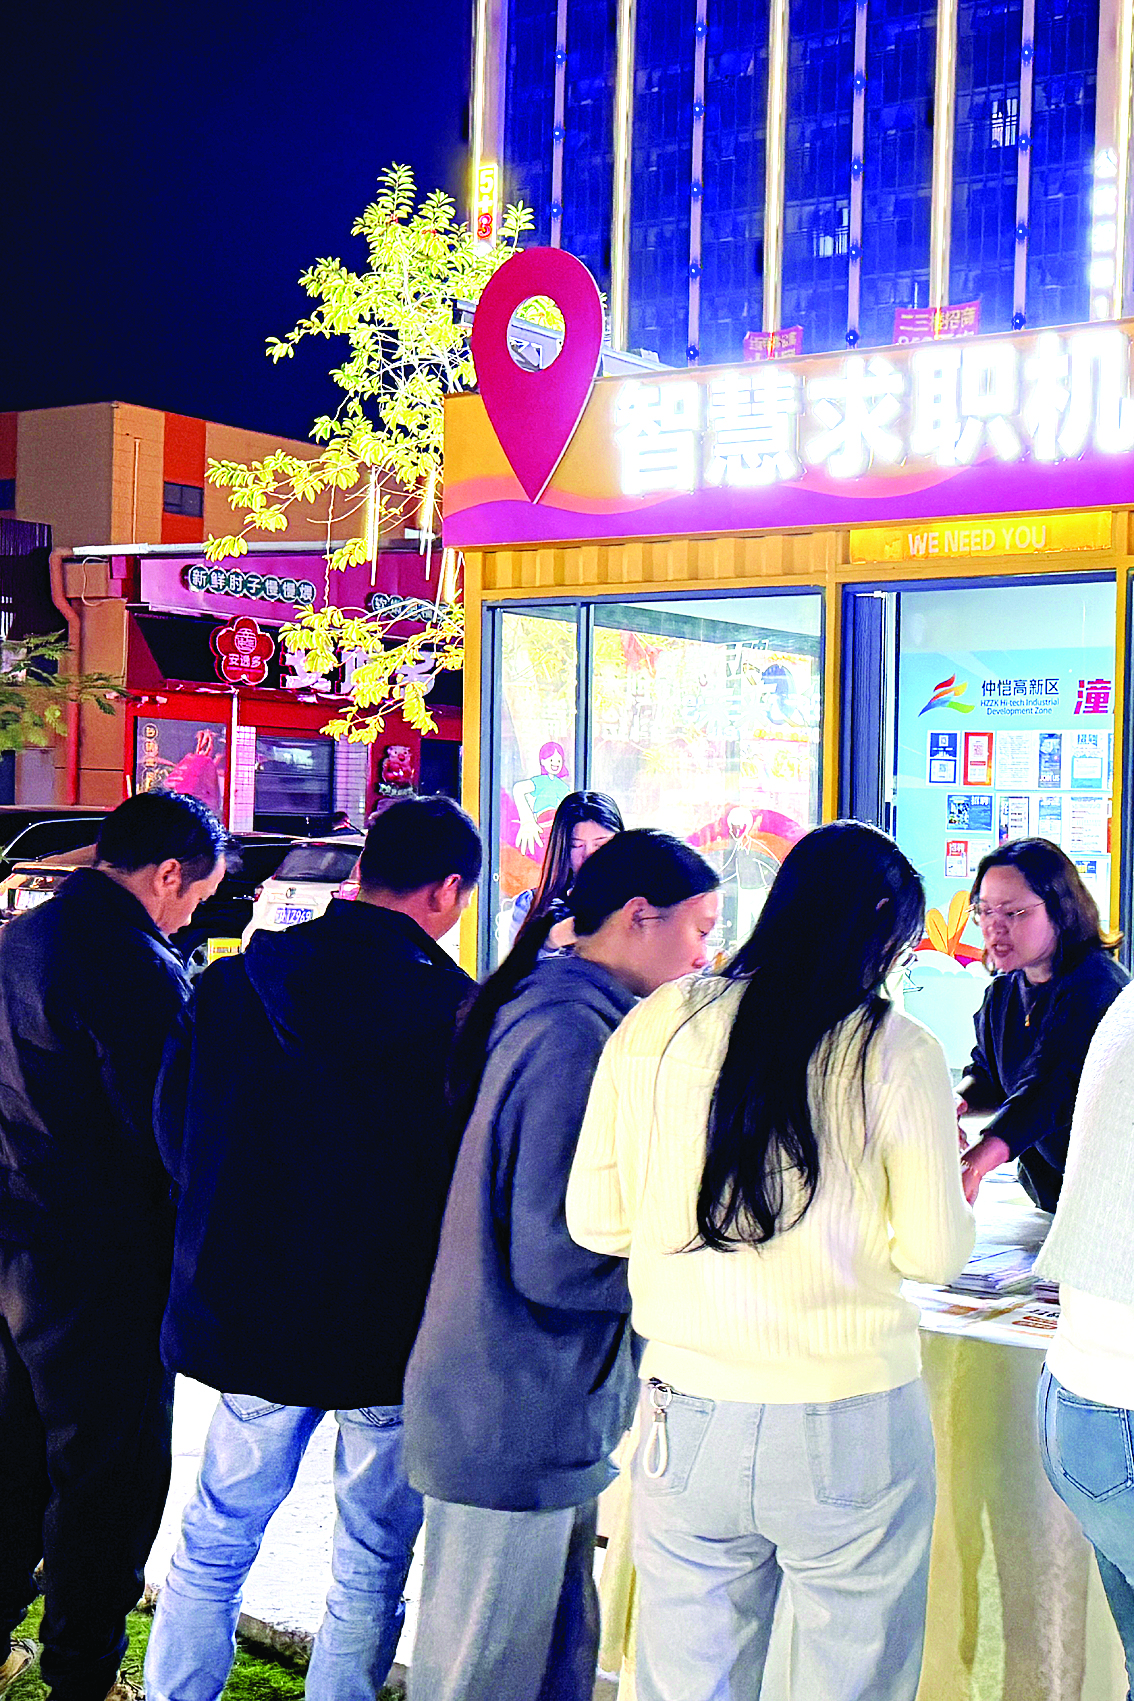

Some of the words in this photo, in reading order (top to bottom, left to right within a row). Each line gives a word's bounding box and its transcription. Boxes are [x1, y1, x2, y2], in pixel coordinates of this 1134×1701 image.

[908, 532, 939, 555] WE
[944, 529, 996, 553] NEED
[1001, 525, 1047, 550] YOU
[981, 678, 1060, 697] 仲恺高新区
[1025, 697, 1060, 706] Industrial
[986, 706, 1031, 716] Development
[1034, 706, 1053, 714] Zone
